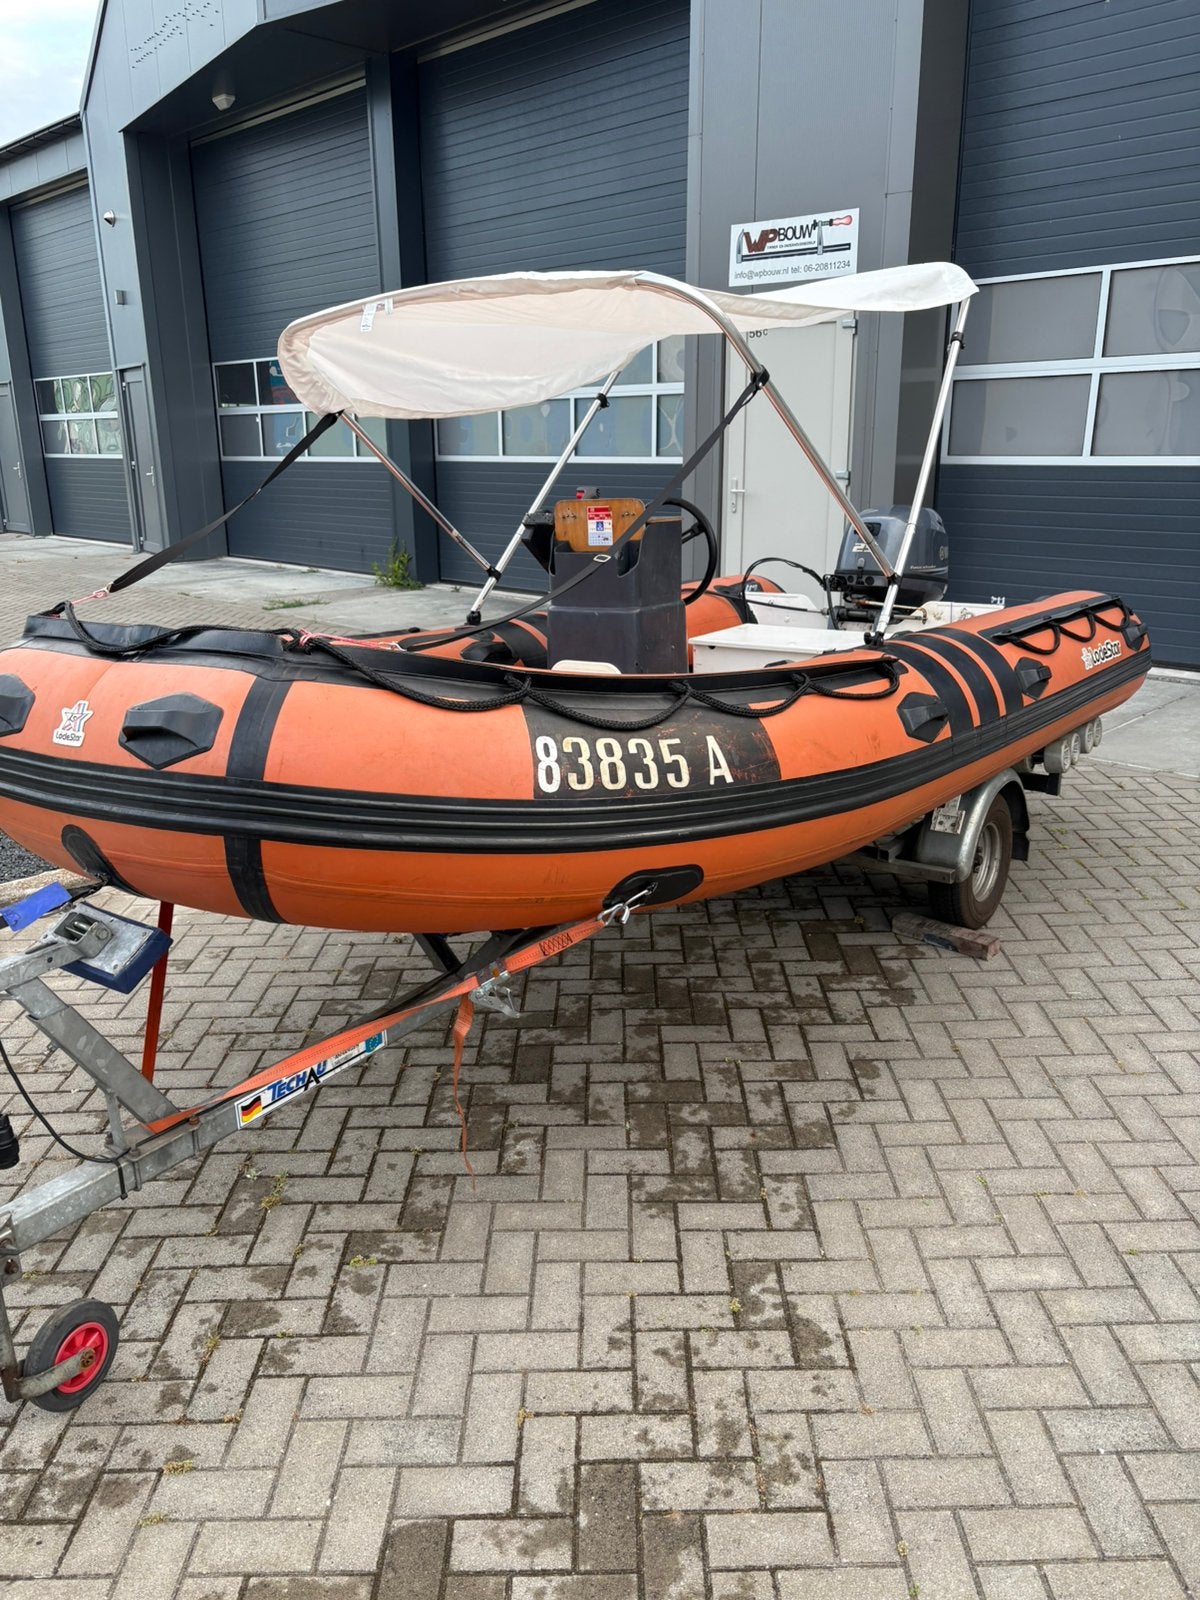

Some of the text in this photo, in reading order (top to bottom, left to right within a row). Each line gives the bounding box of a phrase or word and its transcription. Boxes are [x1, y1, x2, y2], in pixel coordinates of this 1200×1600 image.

[734, 259, 851, 280] info@wpbouw.nl tel: 06-20811234
[535, 735, 735, 793] 83835 A
[266, 1060, 328, 1102] TECHAU
